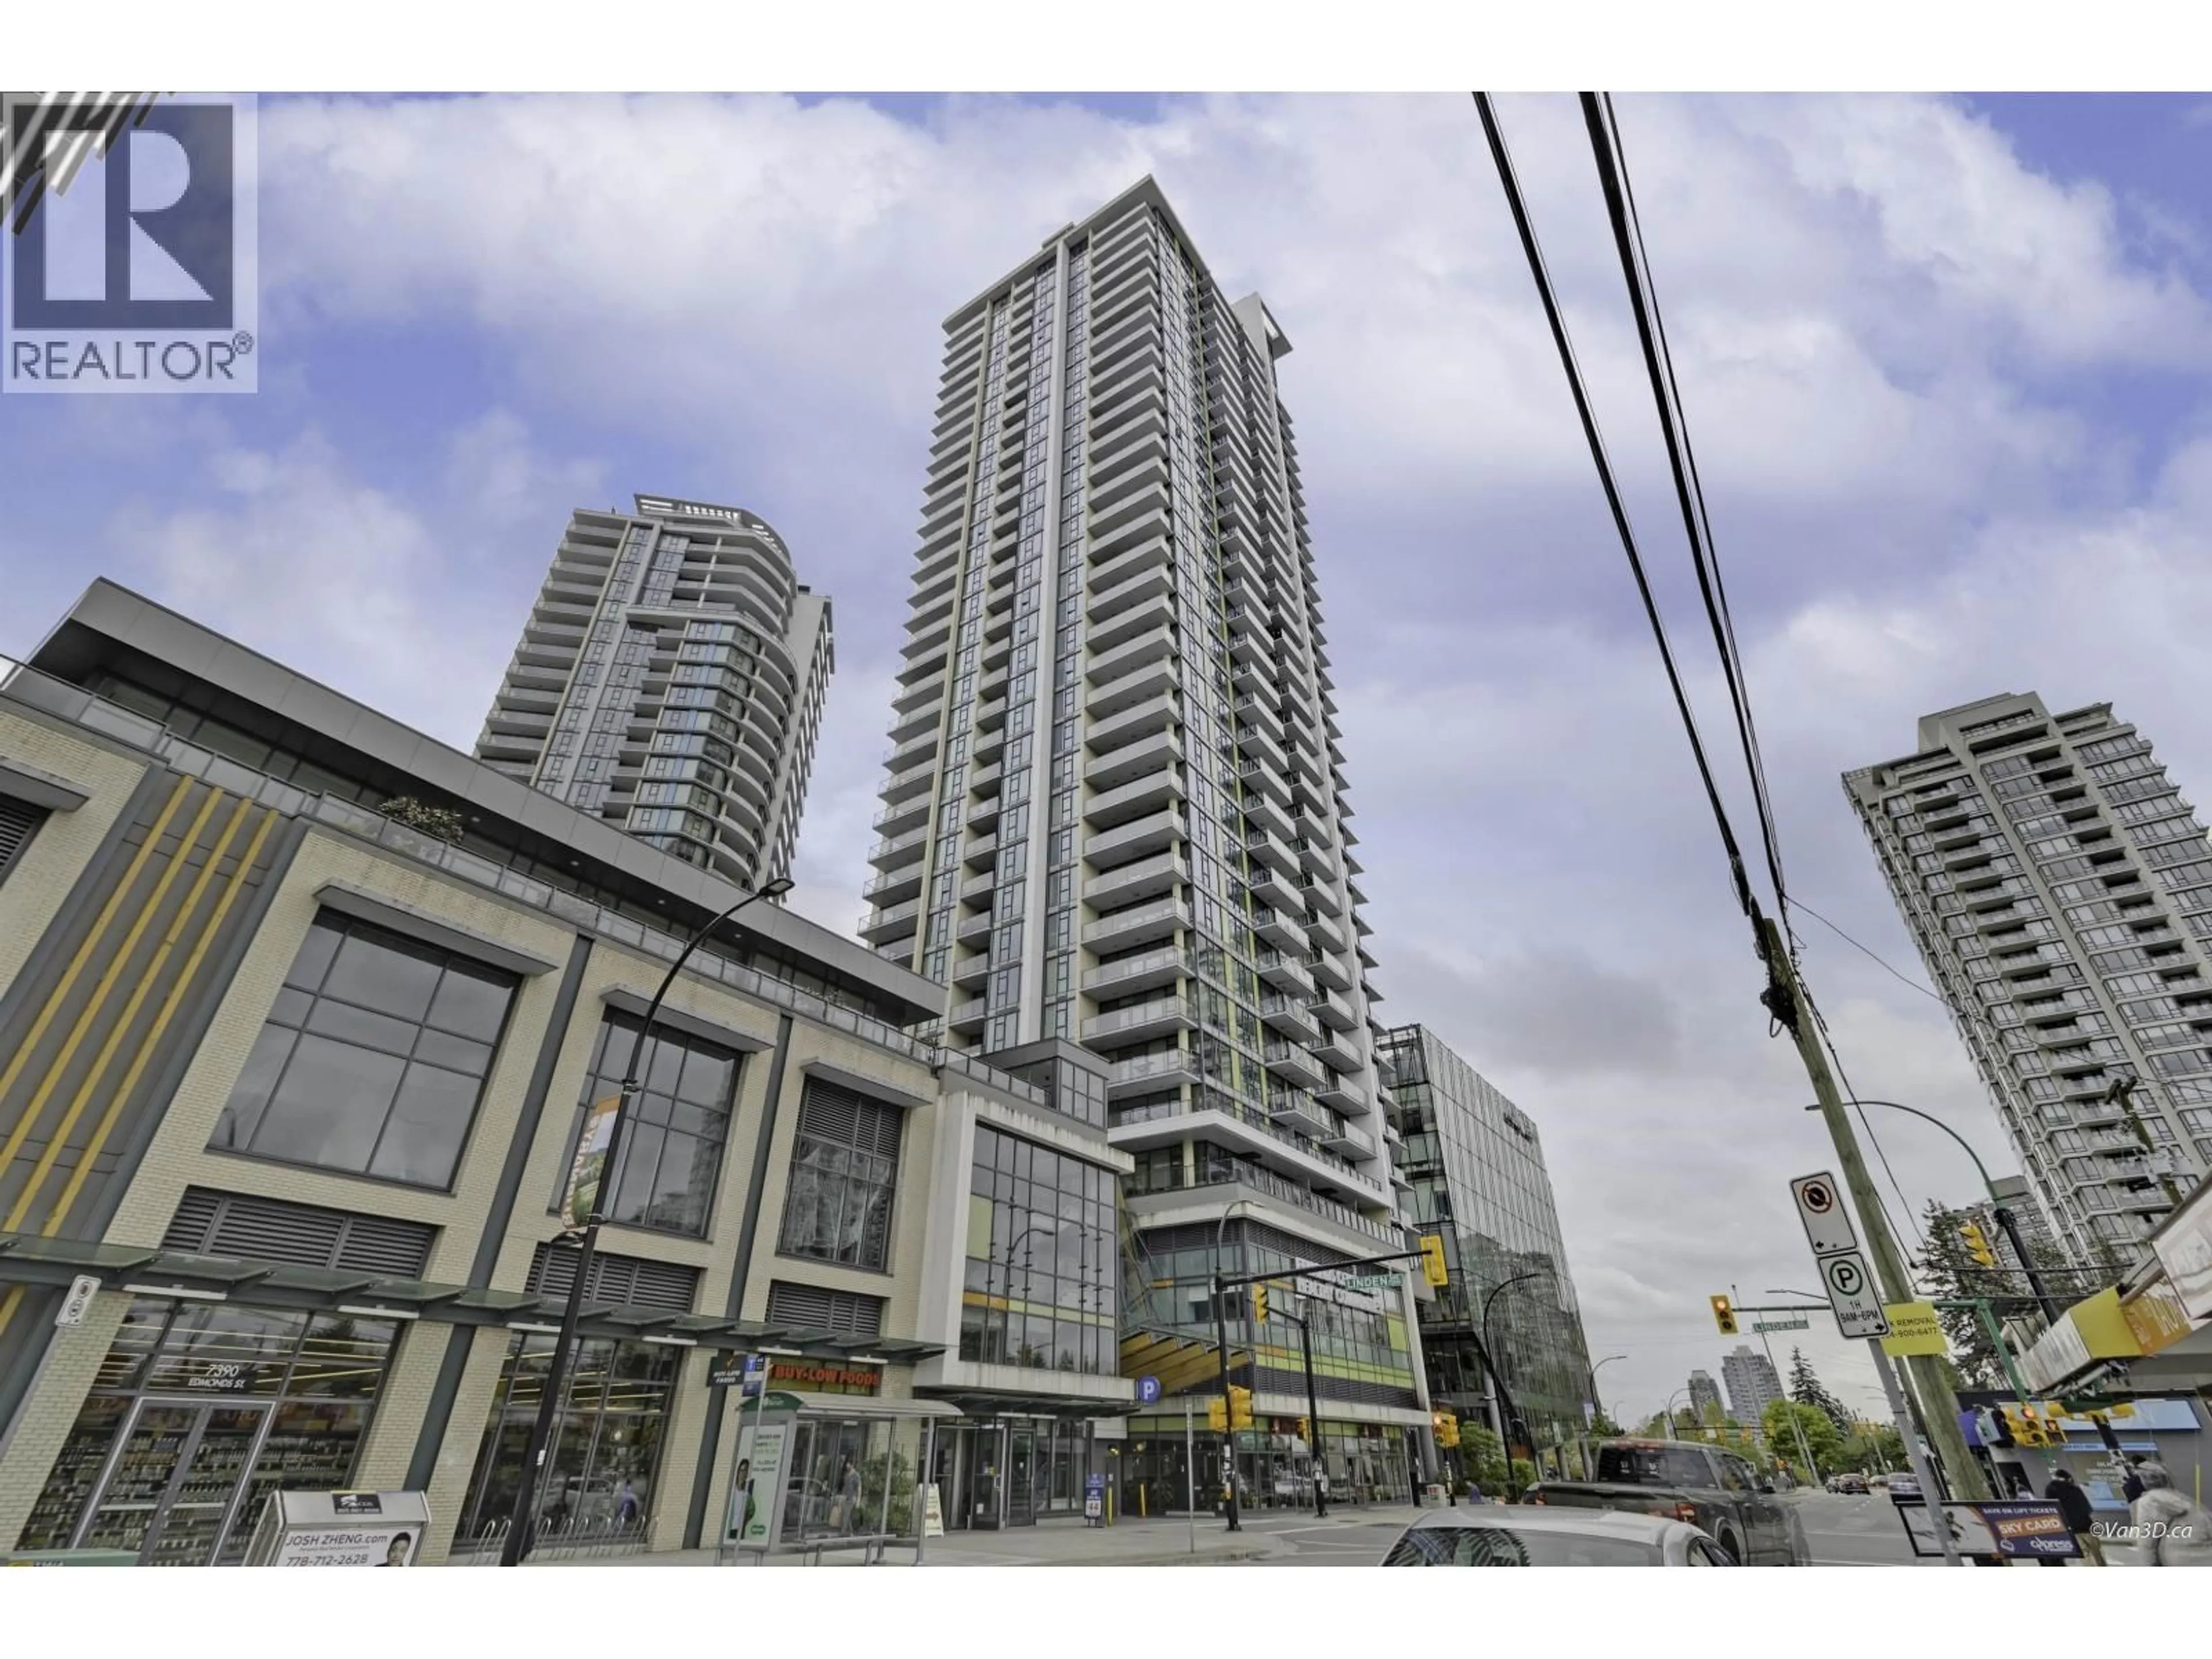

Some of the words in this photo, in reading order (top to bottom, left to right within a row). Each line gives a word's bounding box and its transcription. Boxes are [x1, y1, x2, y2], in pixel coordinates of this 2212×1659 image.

[1348, 1275, 1388, 1289] LINDEN
[206, 1364, 239, 1378] 7390
[774, 1364, 836, 1382] BUY-LOW
[839, 1371, 879, 1386] FOODS
[188, 1377, 233, 1388] EDMONDS
[1143, 1381, 1155, 1400] P
[1998, 1522, 2023, 1535] SKY
[2024, 1518, 2061, 1531] CARD
[286, 1535, 320, 1547] JOSH
[321, 1533, 388, 1546] ZHENG.com
[287, 1553, 369, 1566] 778-712-2628
